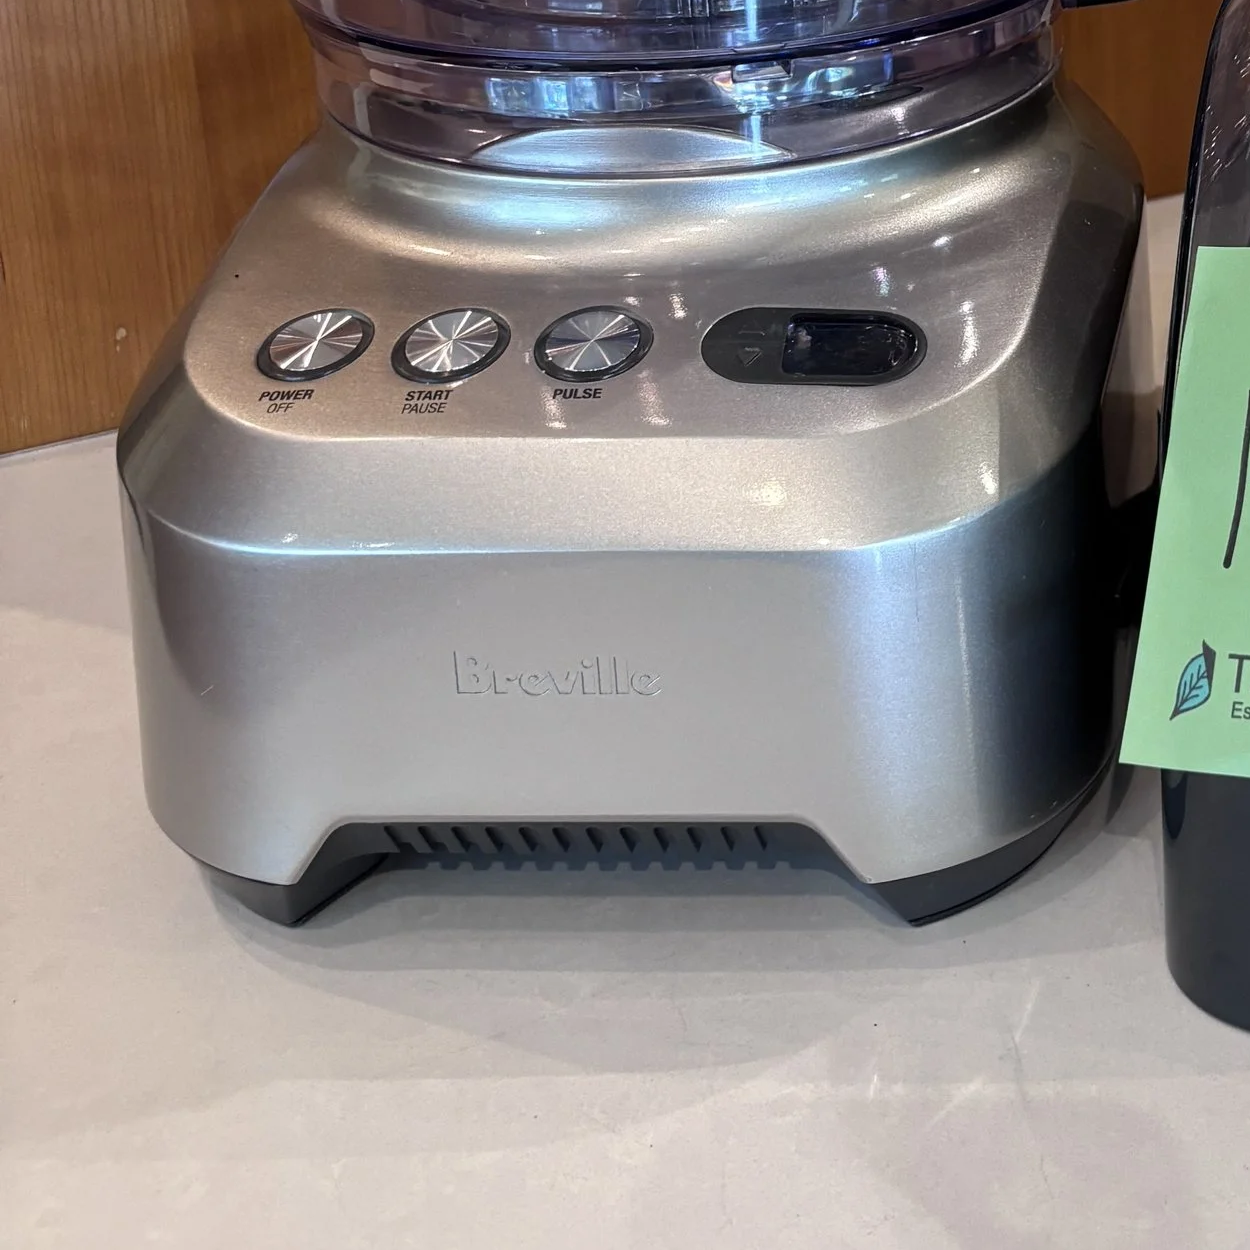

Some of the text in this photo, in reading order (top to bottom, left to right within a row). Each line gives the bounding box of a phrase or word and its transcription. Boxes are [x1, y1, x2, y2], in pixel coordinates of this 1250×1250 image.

[258, 388, 315, 403] POWER
[404, 388, 454, 403] START
[552, 387, 603, 401] PULSE
[266, 401, 295, 414] OFF
[401, 401, 447, 415] PAUSE
[453, 649, 663, 697] Breville
